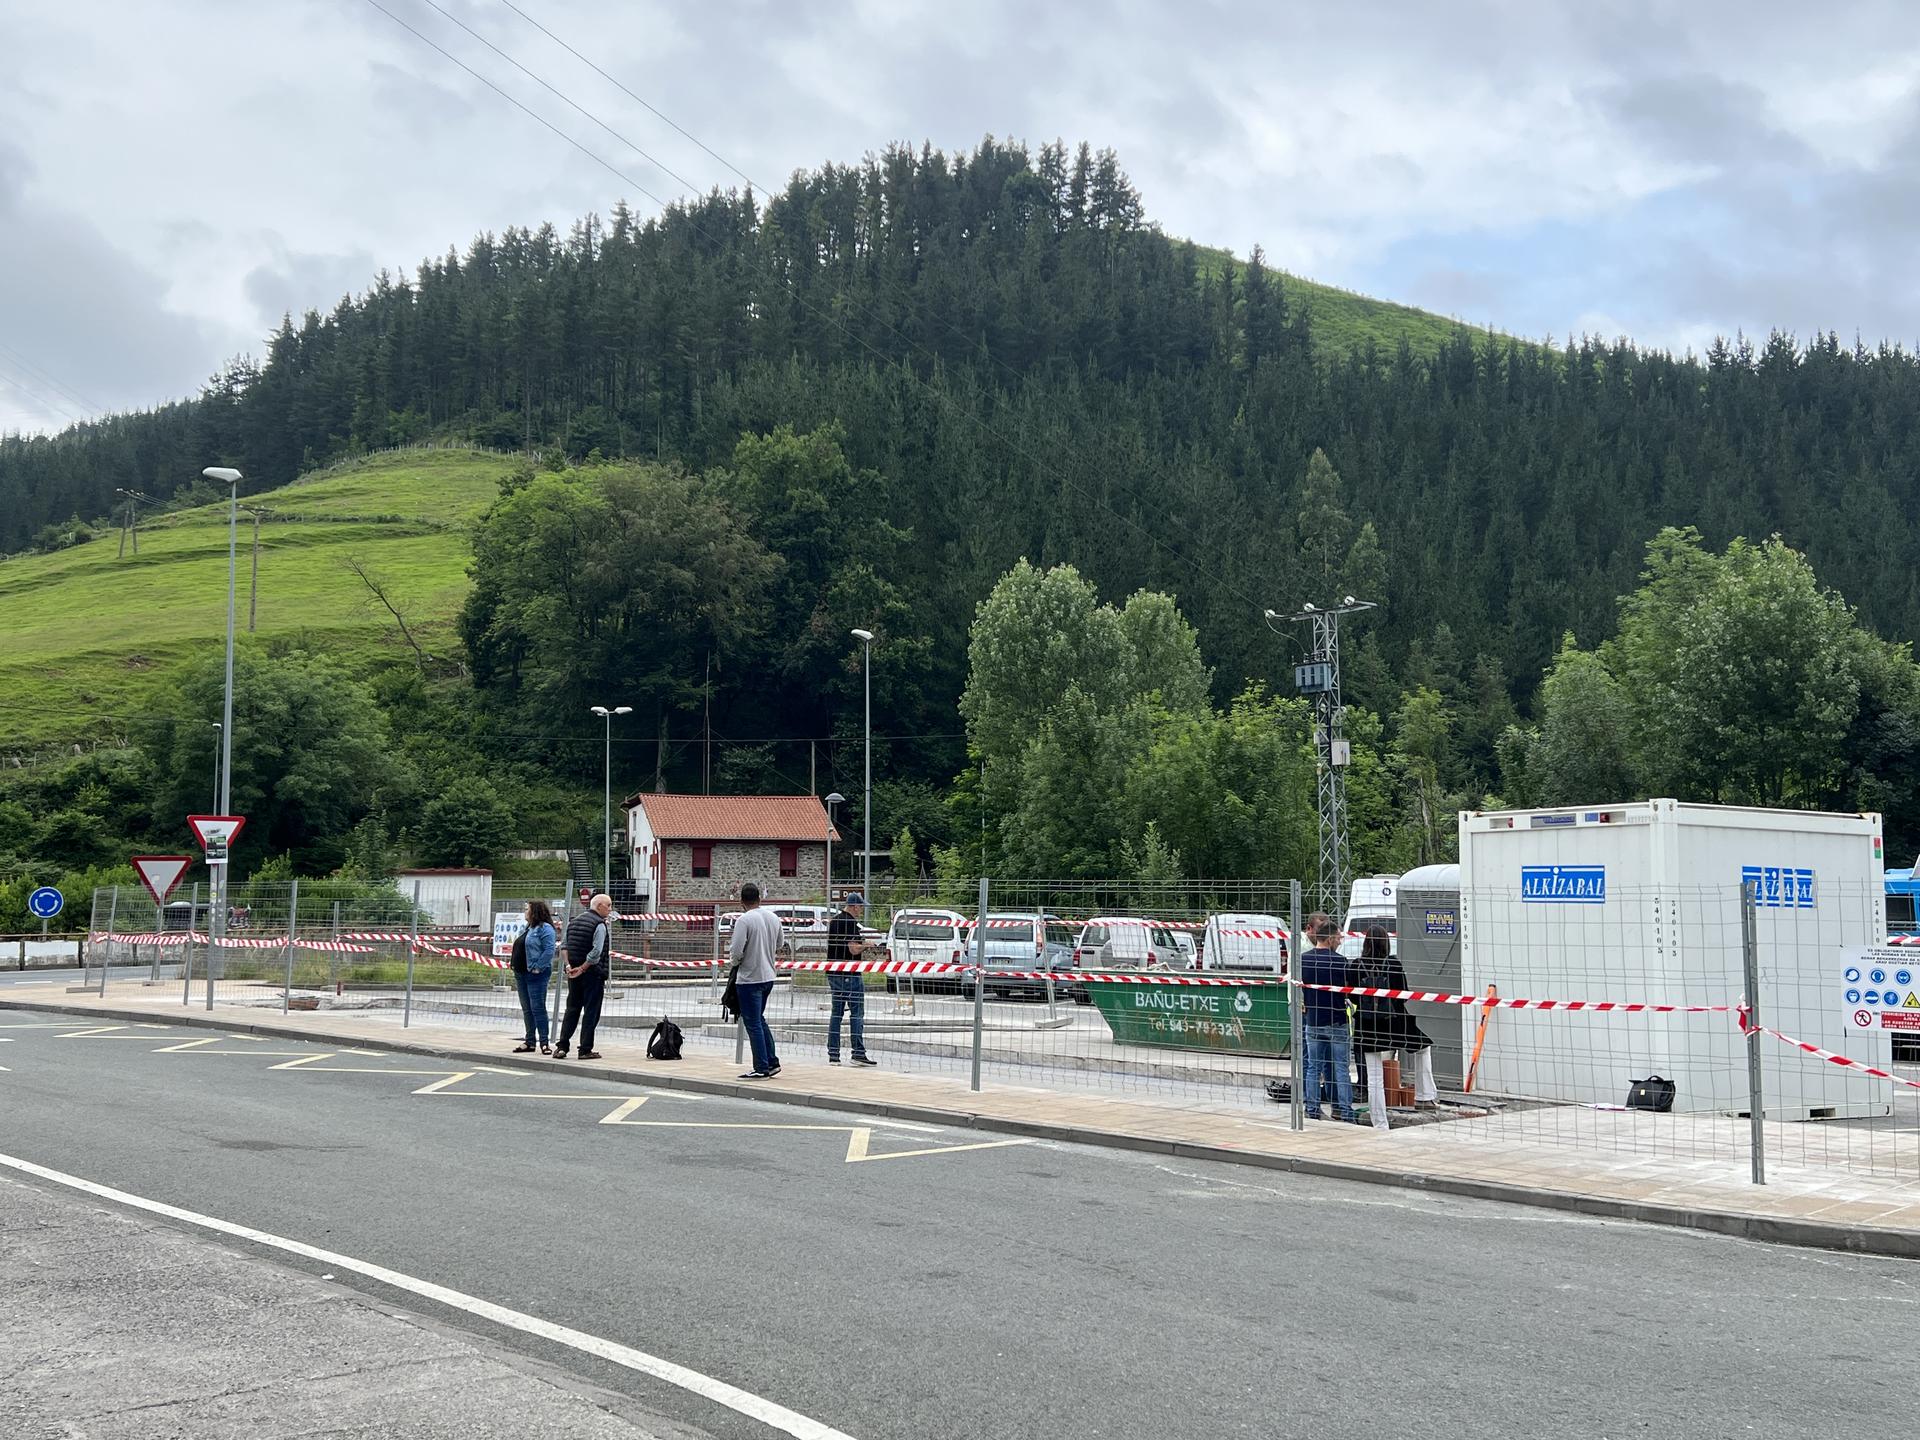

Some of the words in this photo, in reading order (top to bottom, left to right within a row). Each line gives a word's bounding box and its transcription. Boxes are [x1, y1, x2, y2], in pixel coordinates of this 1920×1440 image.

[1523, 867, 1605, 896] ALKIZABAL
[1135, 989, 1220, 1012] BAÑU-ETXE
[1149, 1017, 1168, 1031] Tel.
